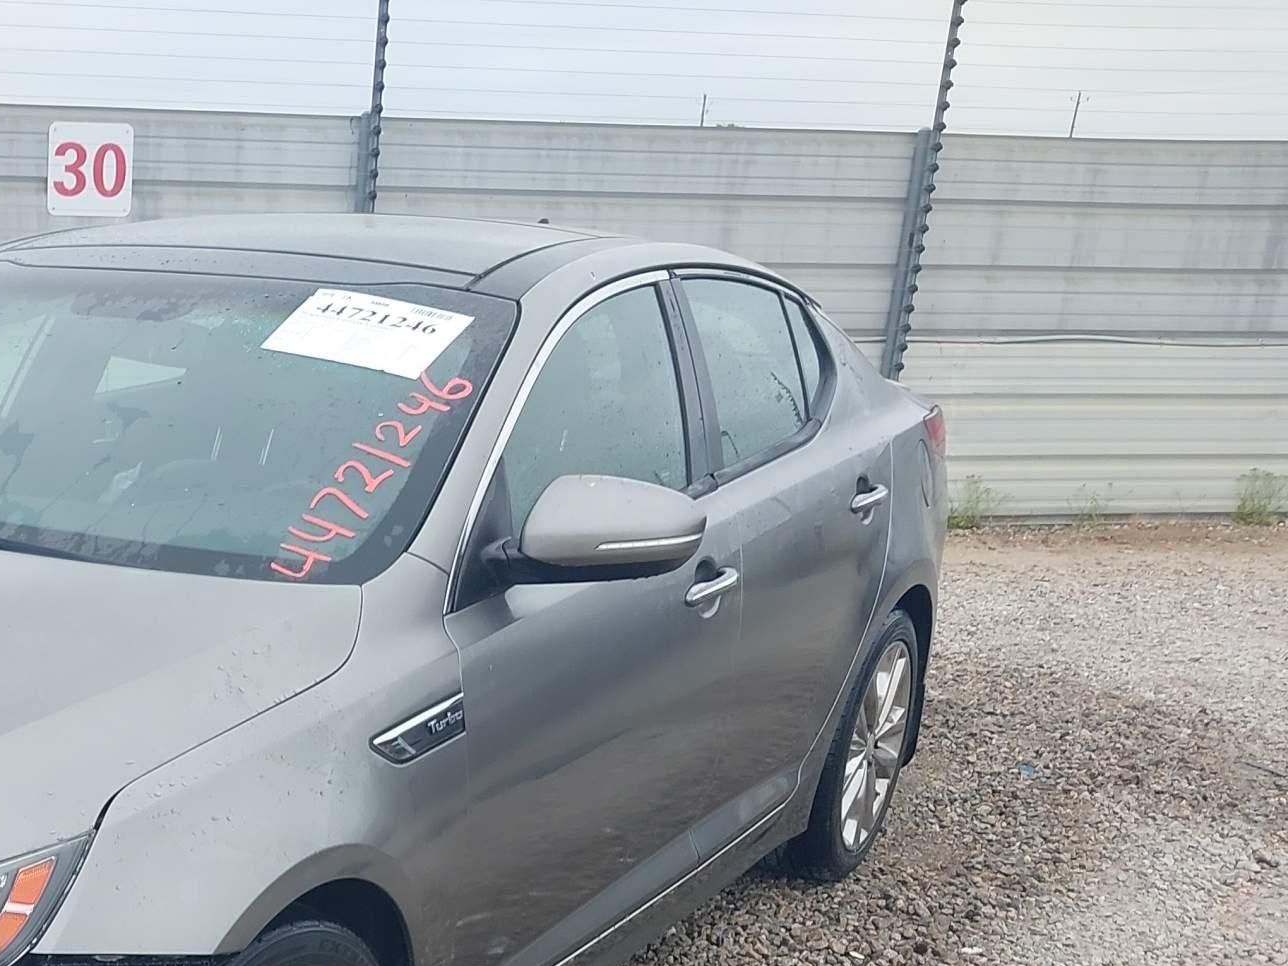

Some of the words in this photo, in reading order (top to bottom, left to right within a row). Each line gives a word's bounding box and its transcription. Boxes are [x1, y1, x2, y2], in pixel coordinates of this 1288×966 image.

[53, 142, 127, 198] 30
[316, 303, 436, 335] 44721246
[270, 371, 473, 578] 44721246
[427, 710, 463, 734] Turbo
